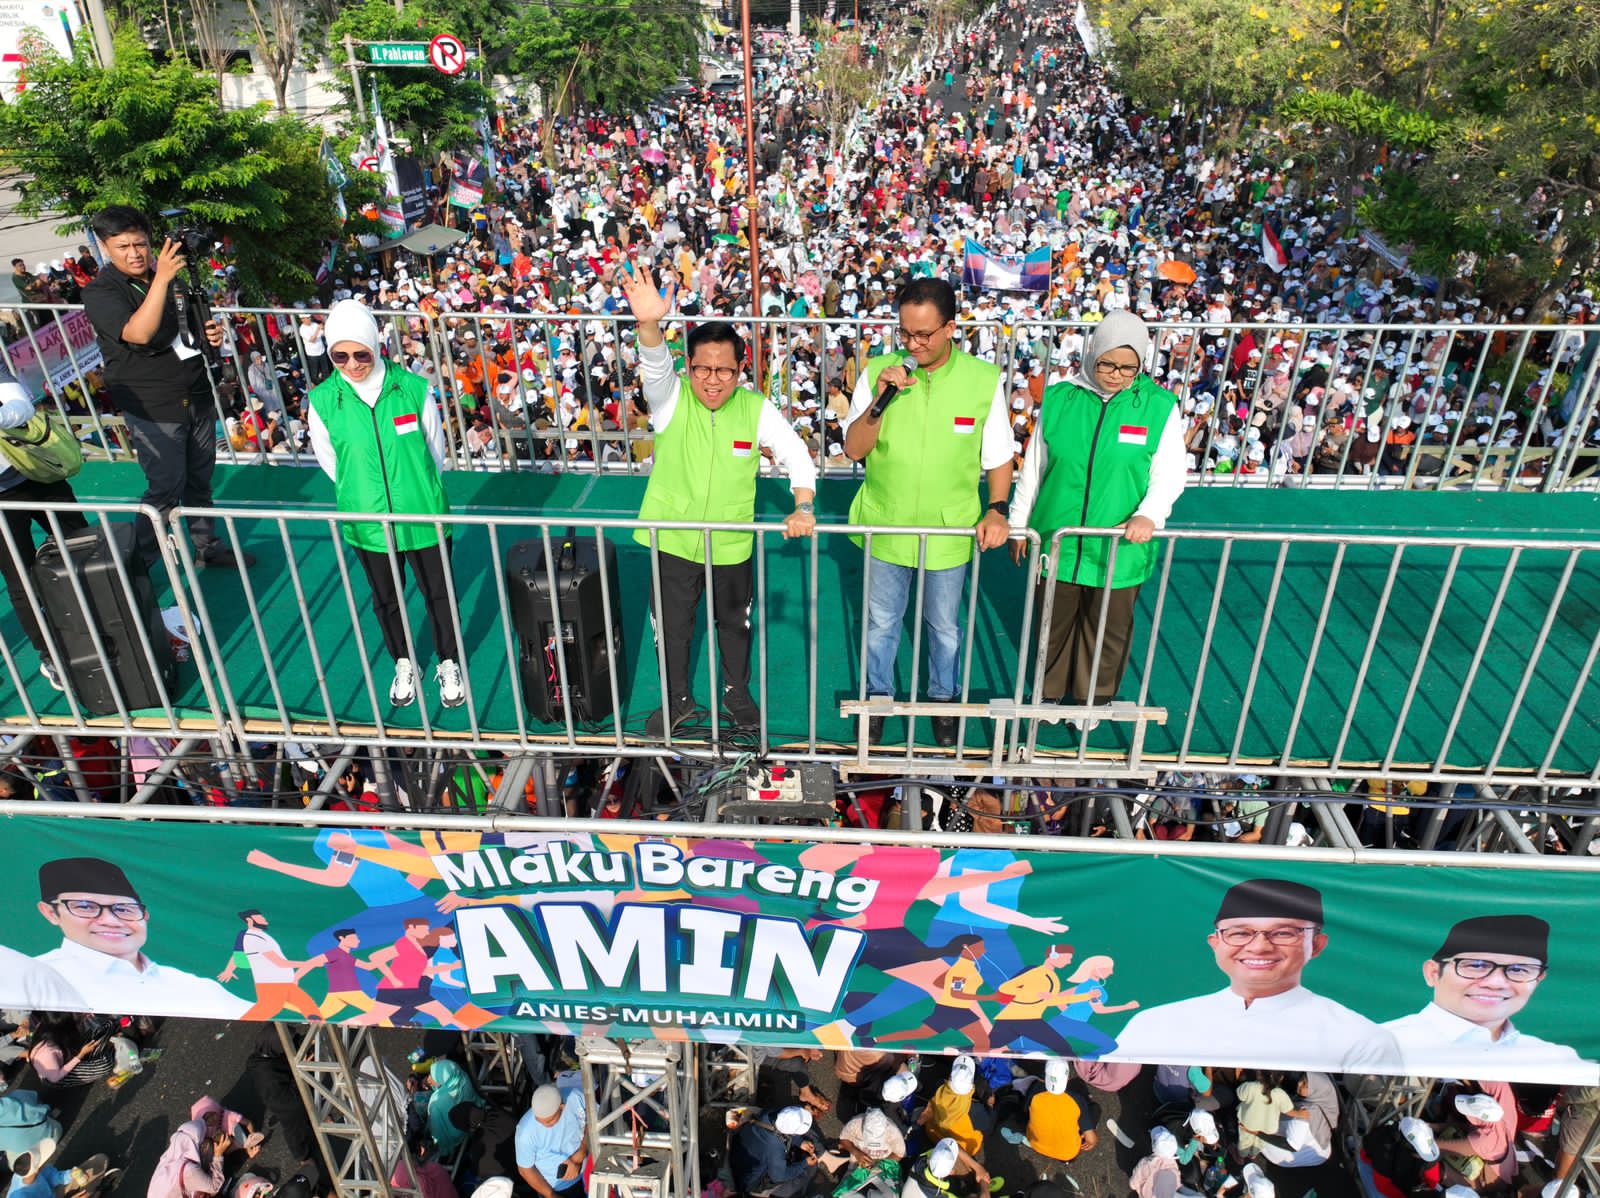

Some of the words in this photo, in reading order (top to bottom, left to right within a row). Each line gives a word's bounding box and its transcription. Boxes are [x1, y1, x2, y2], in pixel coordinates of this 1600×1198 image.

[382, 47, 425, 60] Pahlawan
[431, 841, 626, 891] Mlaku
[638, 842, 880, 912] Bareng
[455, 903, 863, 1012] AMIN
[516, 1002, 798, 1030] ANIES-MUHAIMIN
